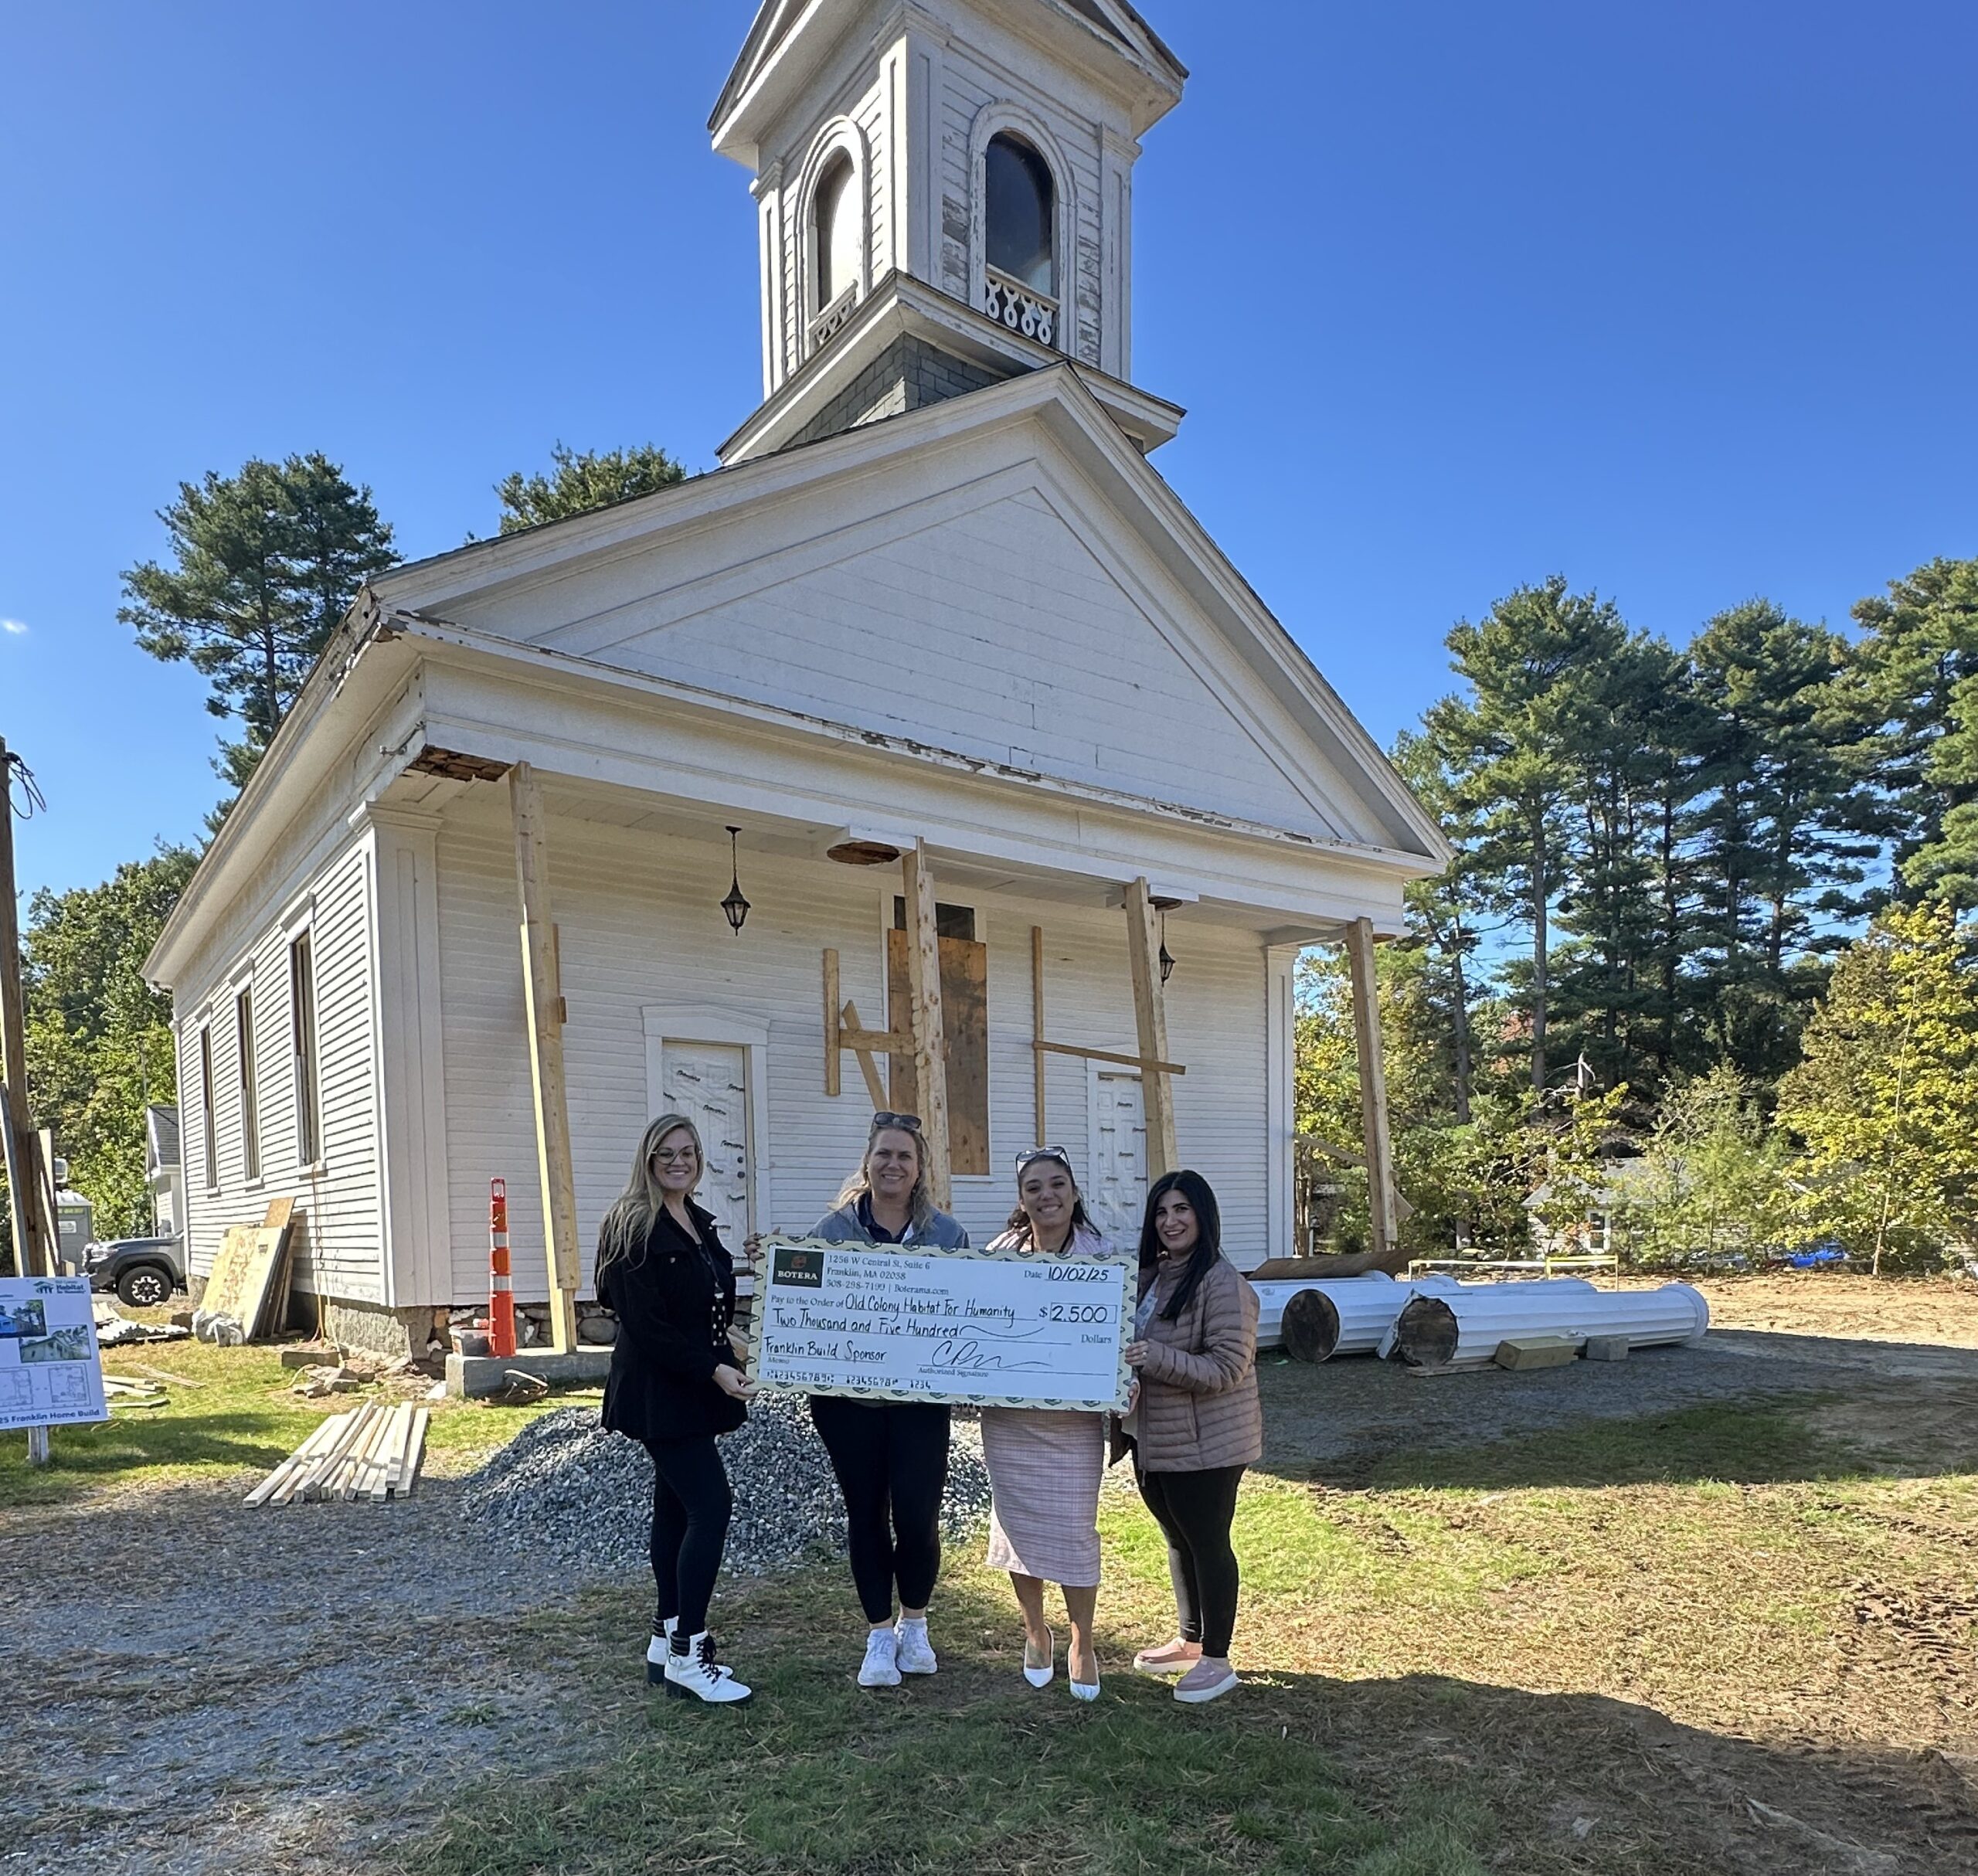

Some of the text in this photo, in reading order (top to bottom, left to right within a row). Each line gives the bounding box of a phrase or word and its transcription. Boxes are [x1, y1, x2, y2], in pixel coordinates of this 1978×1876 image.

[851, 1256, 860, 1265] W
[862, 1257, 891, 1267] Central
[904, 1260, 923, 1269] Suite
[777, 1269, 818, 1280] BOTERA
[827, 1266, 906, 1280] Franklin, MA 02038
[1024, 1269, 1042, 1279] Date
[1048, 1266, 1110, 1282] 10/02/25
[894, 1283, 949, 1296] Boterama.com
[771, 1295, 784, 1305] Pay
[796, 1297, 808, 1305] the
[810, 1297, 834, 1307] Order
[845, 1293, 865, 1310] Old
[868, 1295, 900, 1323] Colony
[903, 1297, 942, 1314] Habitat
[964, 1297, 1015, 1328] Humanity
[1038, 1306, 1048, 1318] $
[772, 1307, 959, 1337] Two Thousand and Five Hundred
[1081, 1334, 1113, 1344] Dollars
[763, 1335, 888, 1364] Franklin Build Sponsor
[917, 1367, 989, 1378] Authorized Signature
[11, 1413, 47, 1422] Franklin
[49, 1411, 76, 1419] Home
[77, 1408, 100, 1417] Build
